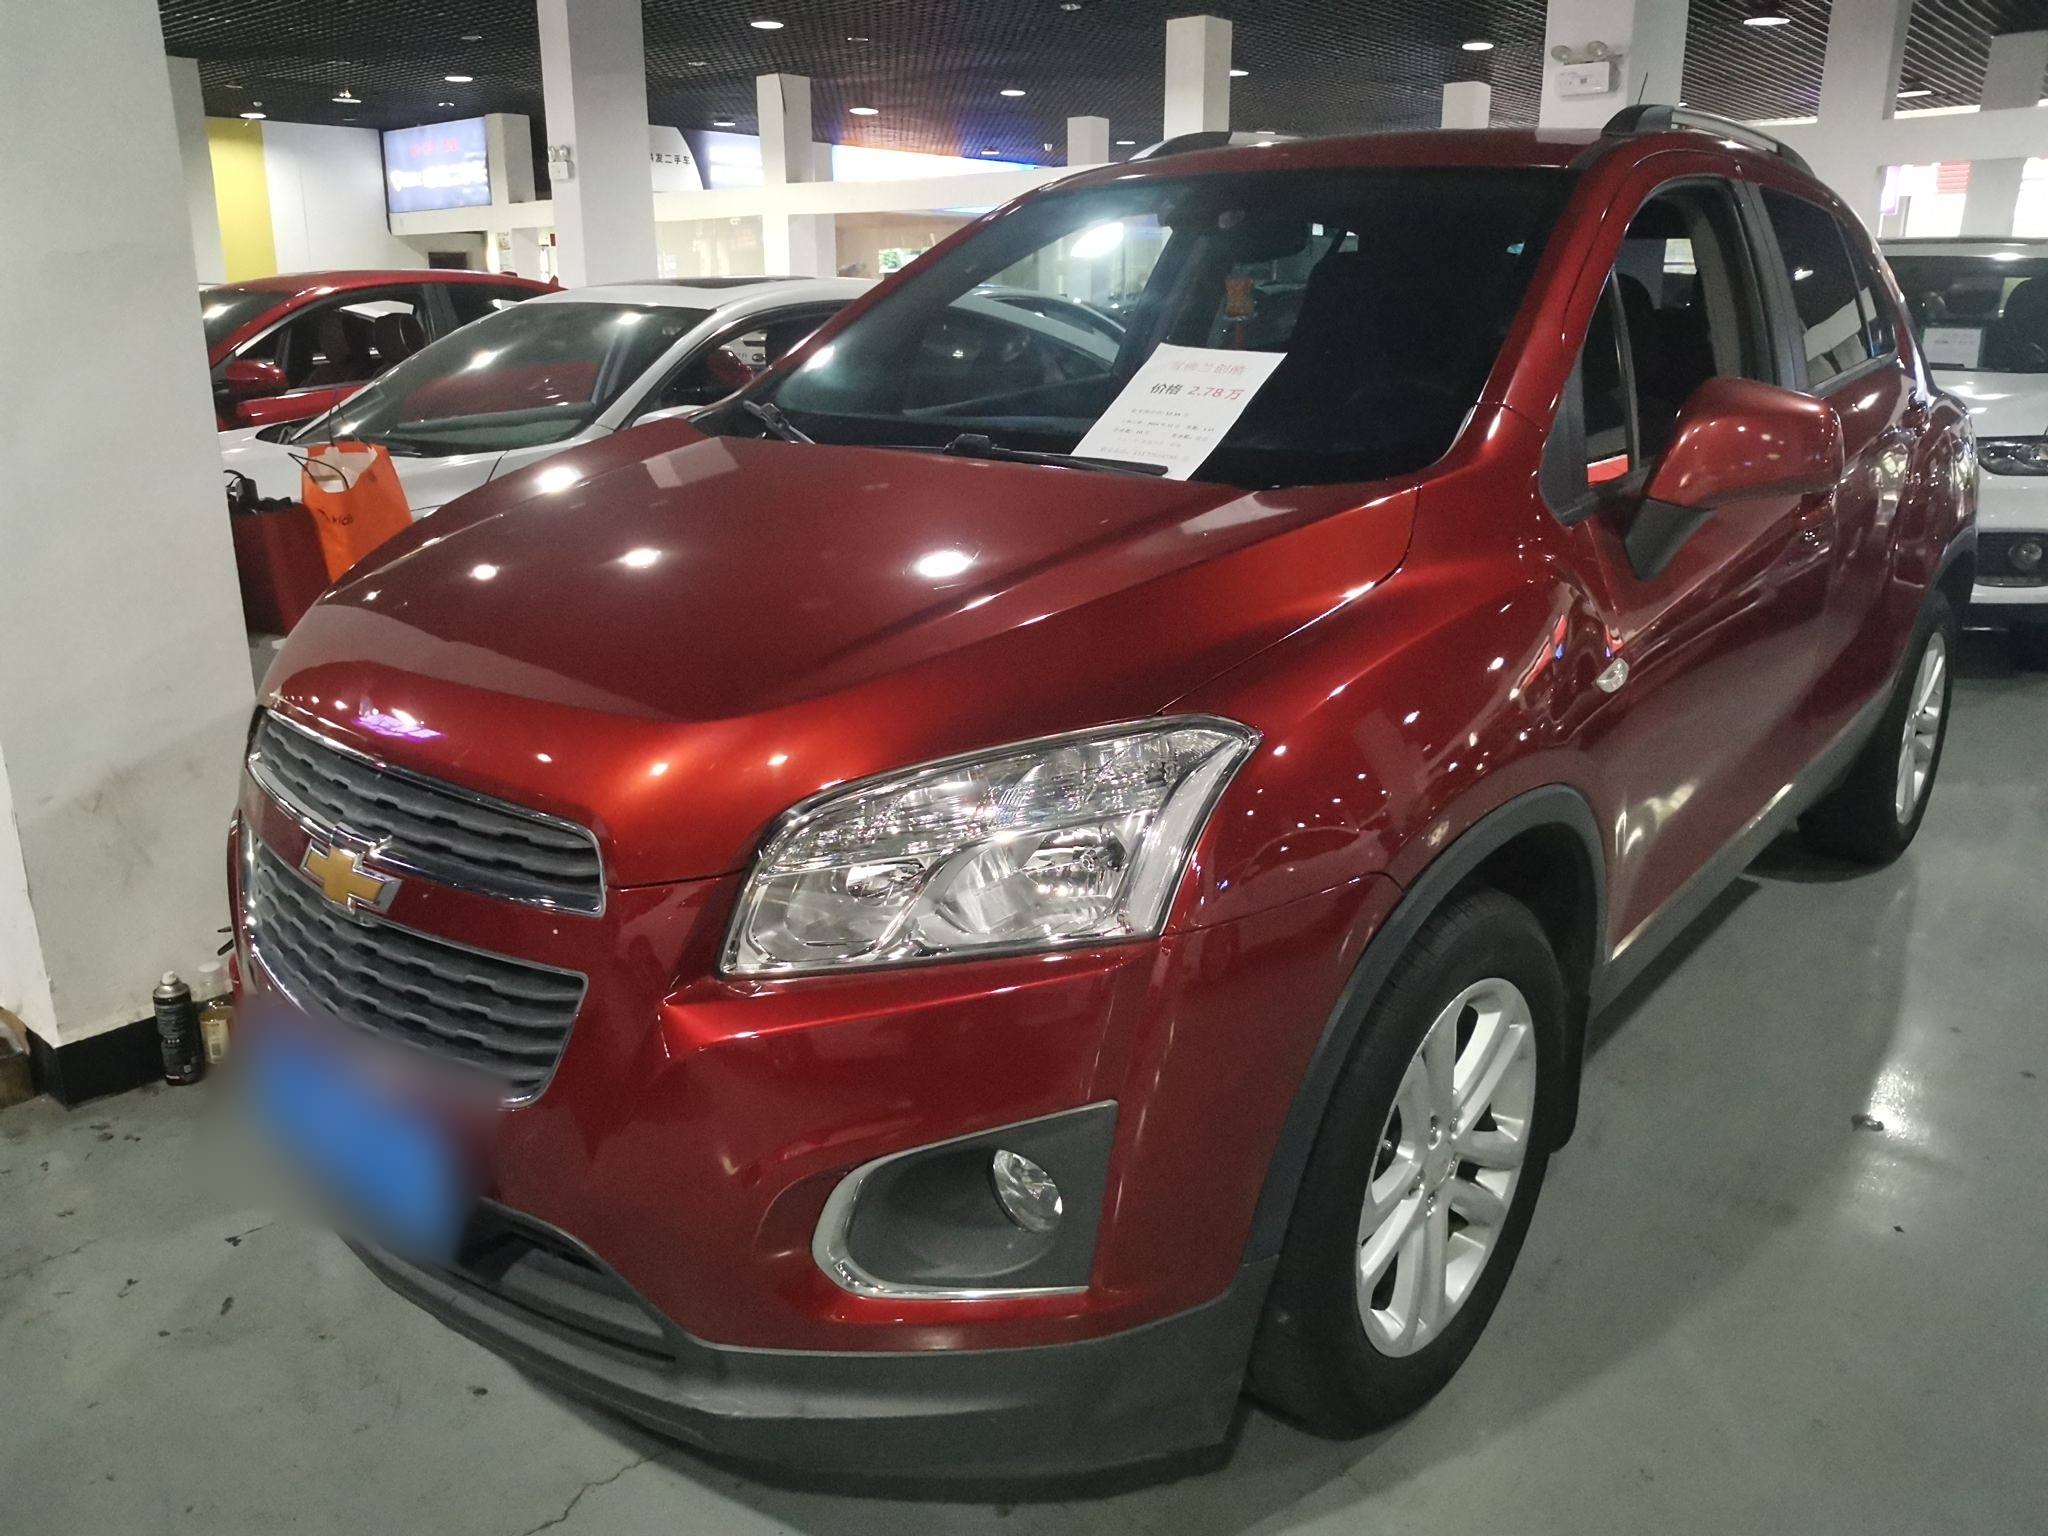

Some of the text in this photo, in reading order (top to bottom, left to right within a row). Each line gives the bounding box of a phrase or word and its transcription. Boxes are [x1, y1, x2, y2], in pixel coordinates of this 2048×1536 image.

[1150, 383, 1245, 400] 价格 2.78 万
